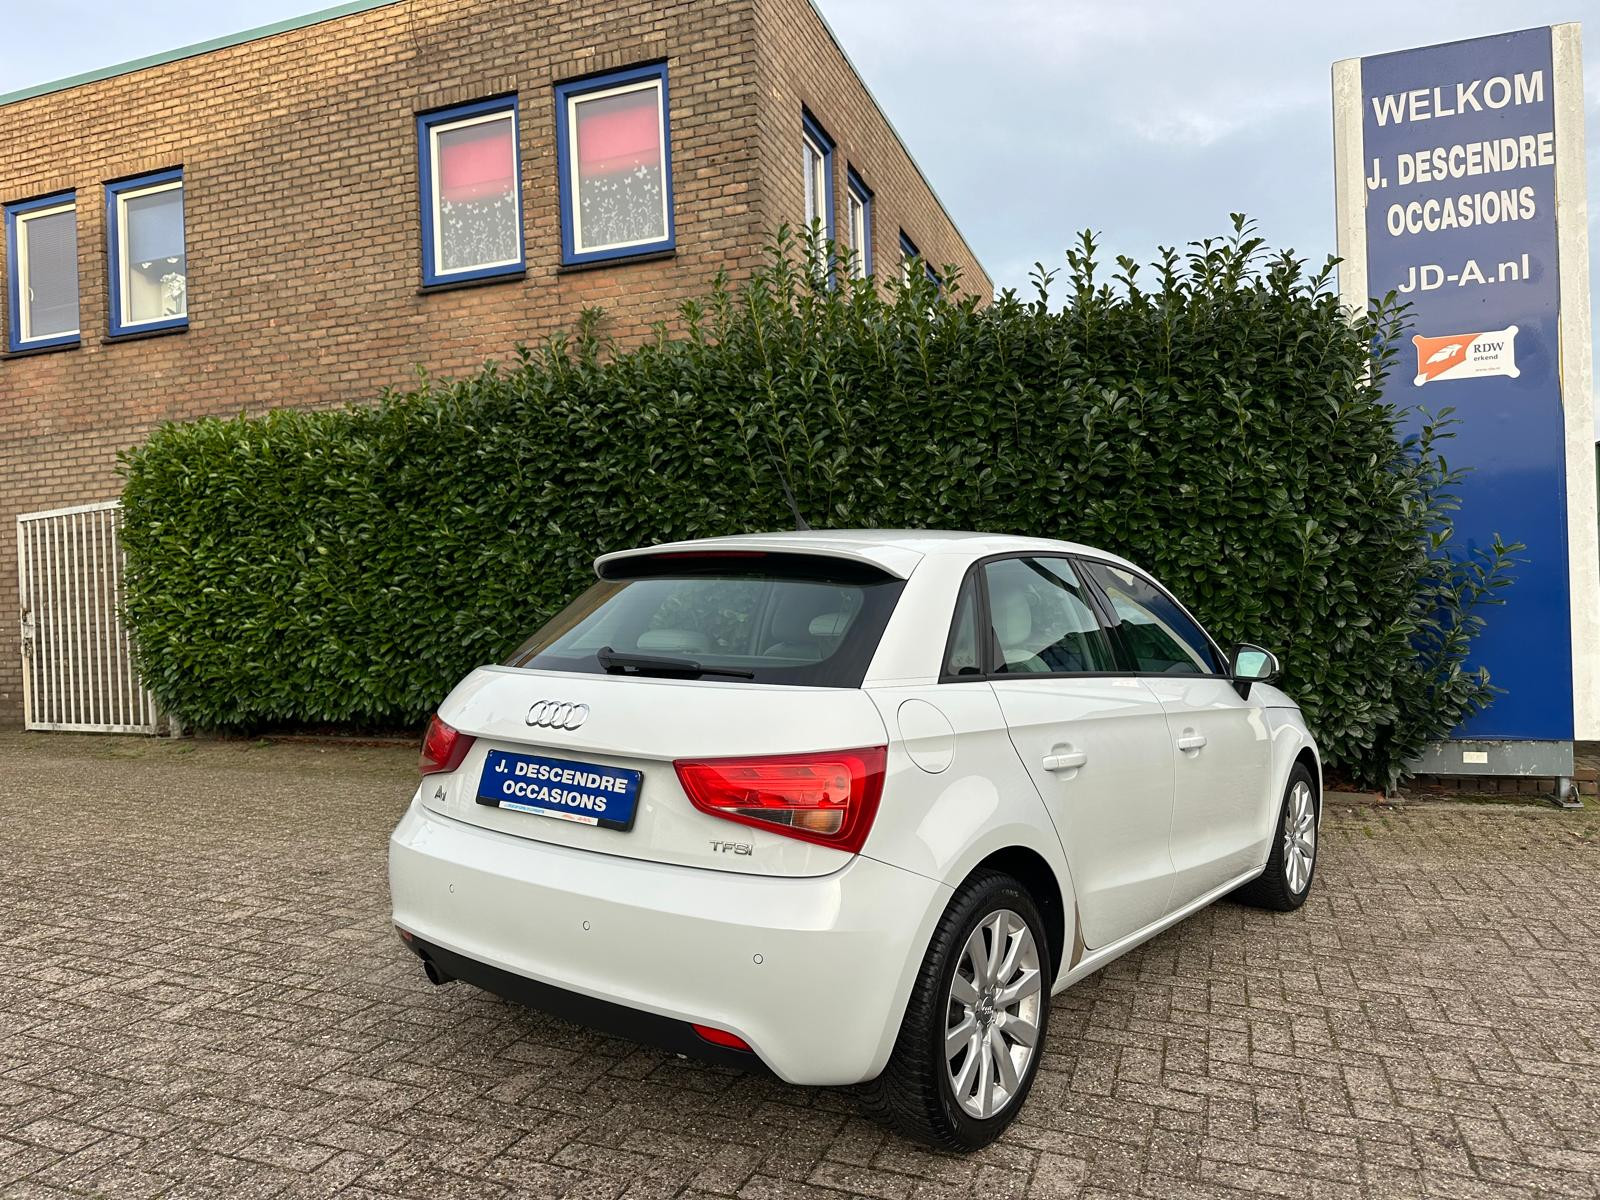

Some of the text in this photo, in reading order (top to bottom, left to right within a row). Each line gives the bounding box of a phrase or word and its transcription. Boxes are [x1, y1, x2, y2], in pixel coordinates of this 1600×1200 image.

[1371, 70, 1544, 127] WELKOM
[1366, 131, 1555, 190] J. DESCENDRE
[1387, 186, 1536, 237] OCCASIONS
[1398, 253, 1530, 293] JD-A.nl
[1473, 341, 1505, 354] RDW
[1473, 354, 1499, 362] erkend
[495, 759, 629, 794] J. DESCENDRE
[502, 780, 607, 812] OCCASIONS
